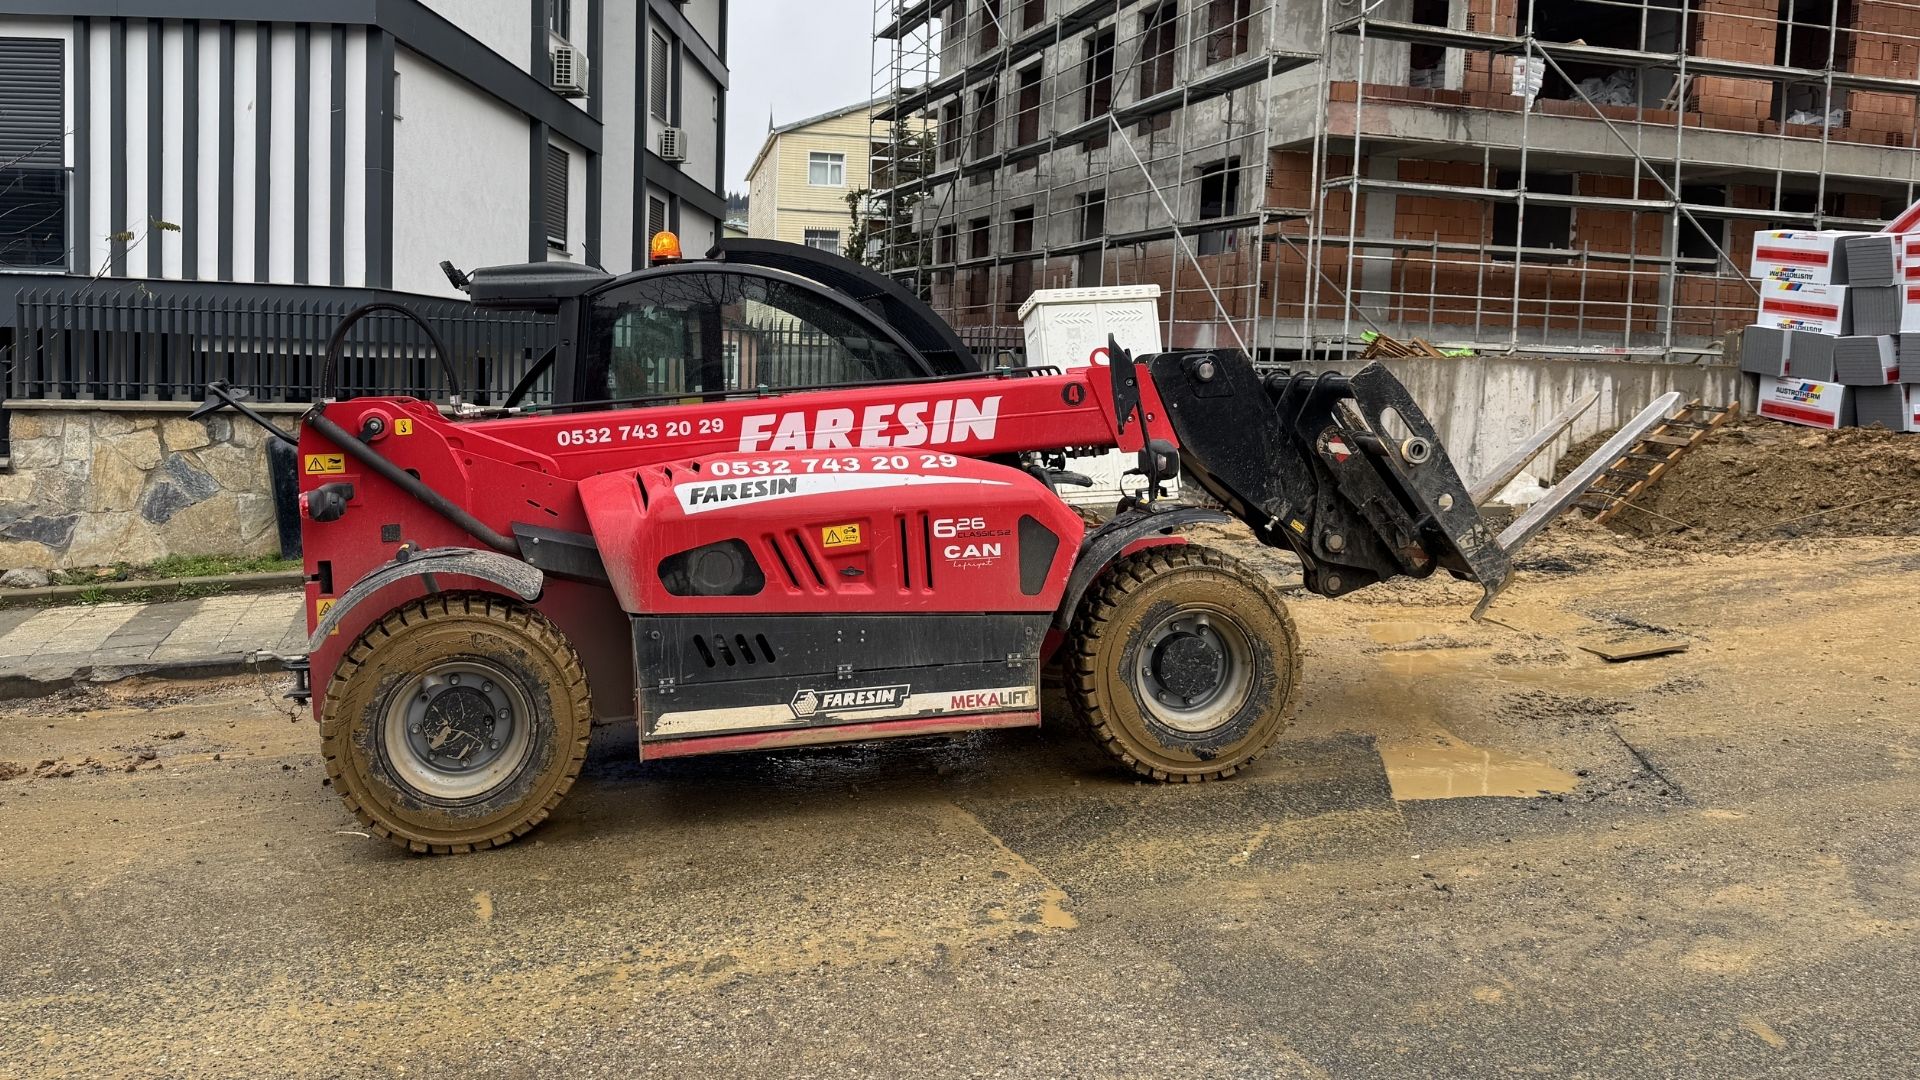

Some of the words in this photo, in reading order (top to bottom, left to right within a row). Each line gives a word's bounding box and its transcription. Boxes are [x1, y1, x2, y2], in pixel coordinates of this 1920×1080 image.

[1068, 385, 1080, 403] 4
[1775, 386, 1821, 400] AUSTROTHERM
[557, 427, 612, 447] 0532
[618, 423, 659, 441] 743
[665, 420, 692, 437] 20
[698, 418, 725, 434] 29
[738, 395, 1003, 454] FARESIN
[710, 458, 791, 477] 0532
[801, 456, 861, 473] 743
[871, 454, 909, 471] 20
[919, 453, 958, 469] 29
[690, 476, 798, 506] FARESIN
[957, 530, 996, 539] CLASSIC
[943, 542, 1001, 559] CAN
[822, 688, 897, 708] FARESIN
